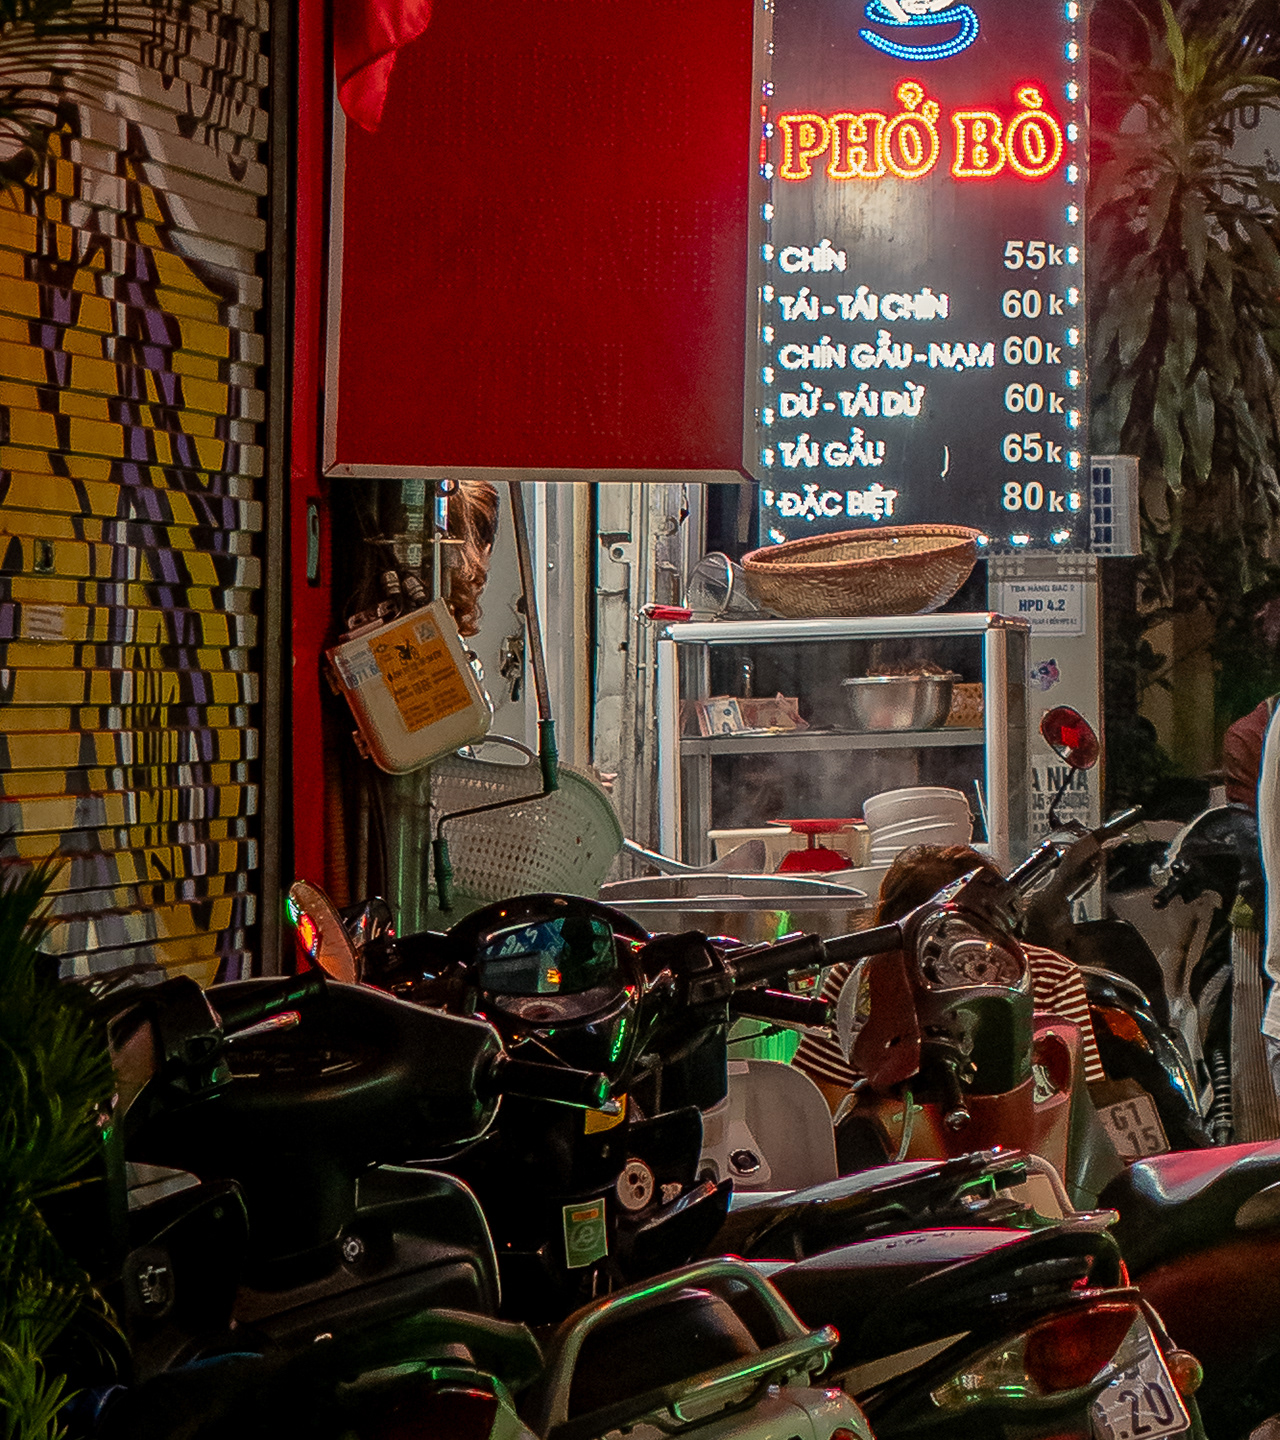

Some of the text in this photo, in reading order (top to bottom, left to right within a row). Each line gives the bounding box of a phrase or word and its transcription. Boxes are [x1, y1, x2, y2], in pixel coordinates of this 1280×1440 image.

[779, 81, 1062, 179] PHỞ BÒ
[778, 239, 847, 272] CHÍN
[778, 286, 816, 321] TÁI
[837, 286, 878, 321] TÁI
[879, 287, 949, 321] CHÍN
[778, 336, 847, 369] CHÍN
[778, 383, 822, 418] DỪ
[838, 384, 878, 418] TÁI
[882, 382, 925, 418] DỪ
[778, 434, 819, 467] TÁI
[775, 484, 842, 520] ĐẶC
[847, 483, 897, 520] BIỆT
[1019, 599, 1066, 612] HPD 4.2
